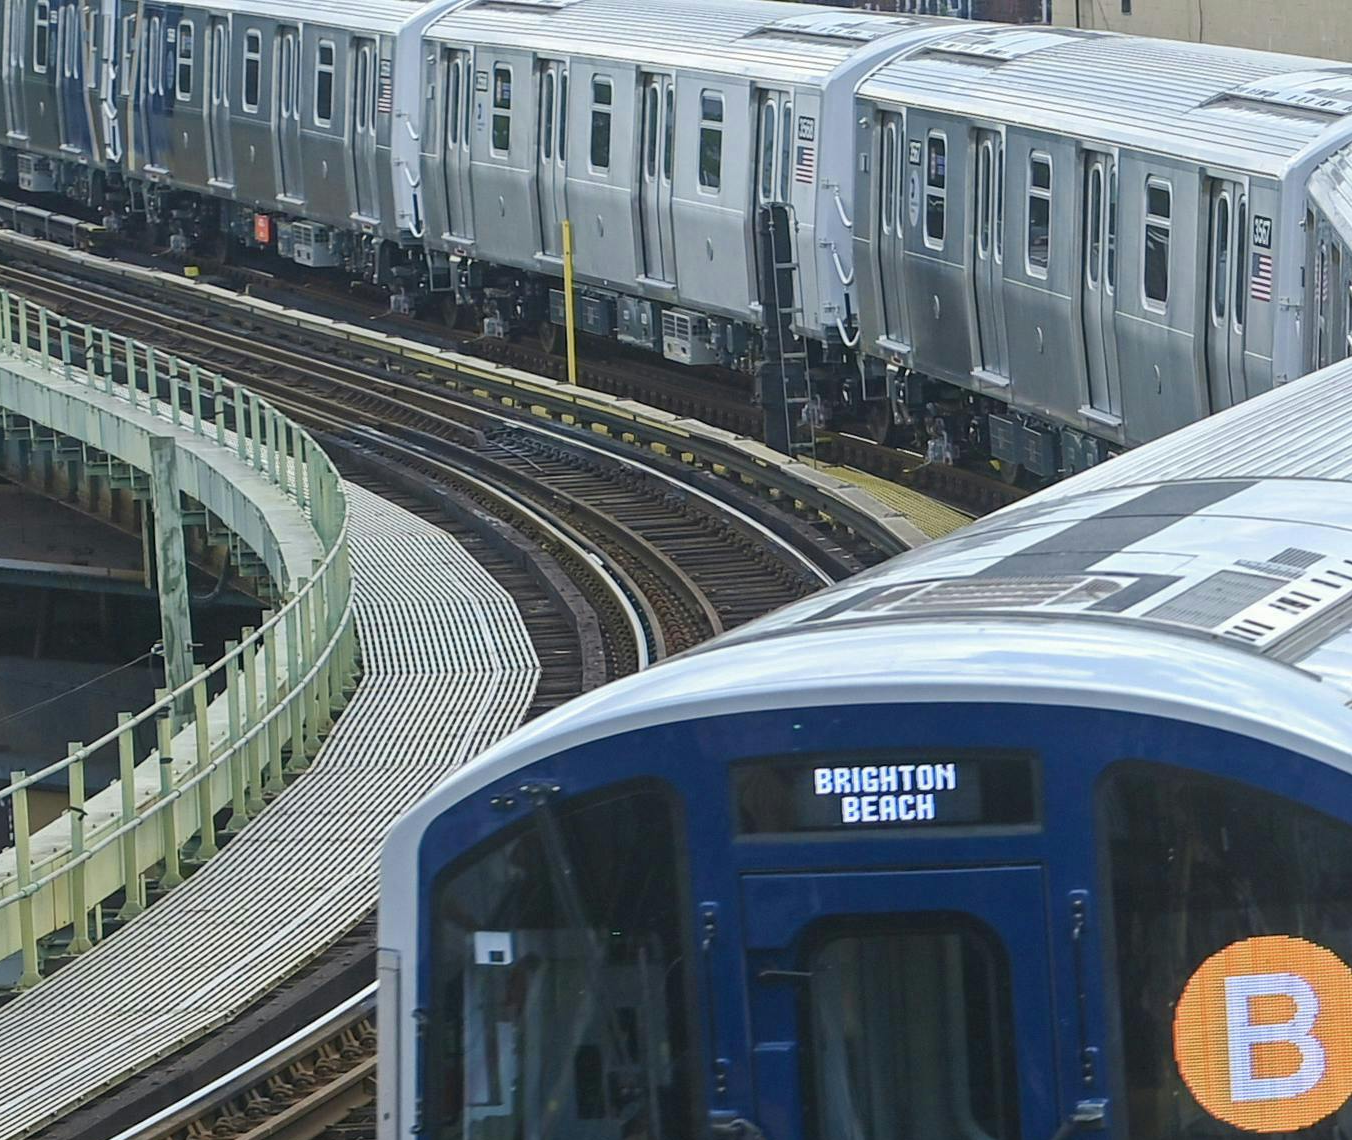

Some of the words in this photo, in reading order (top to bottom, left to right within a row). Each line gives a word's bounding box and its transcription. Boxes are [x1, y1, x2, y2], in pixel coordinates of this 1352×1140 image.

[1254, 218, 1270, 246] 3567
[814, 763, 957, 795] BRIGHTON
[841, 793, 936, 823] BEACH
[1224, 972, 1327, 1103] B
